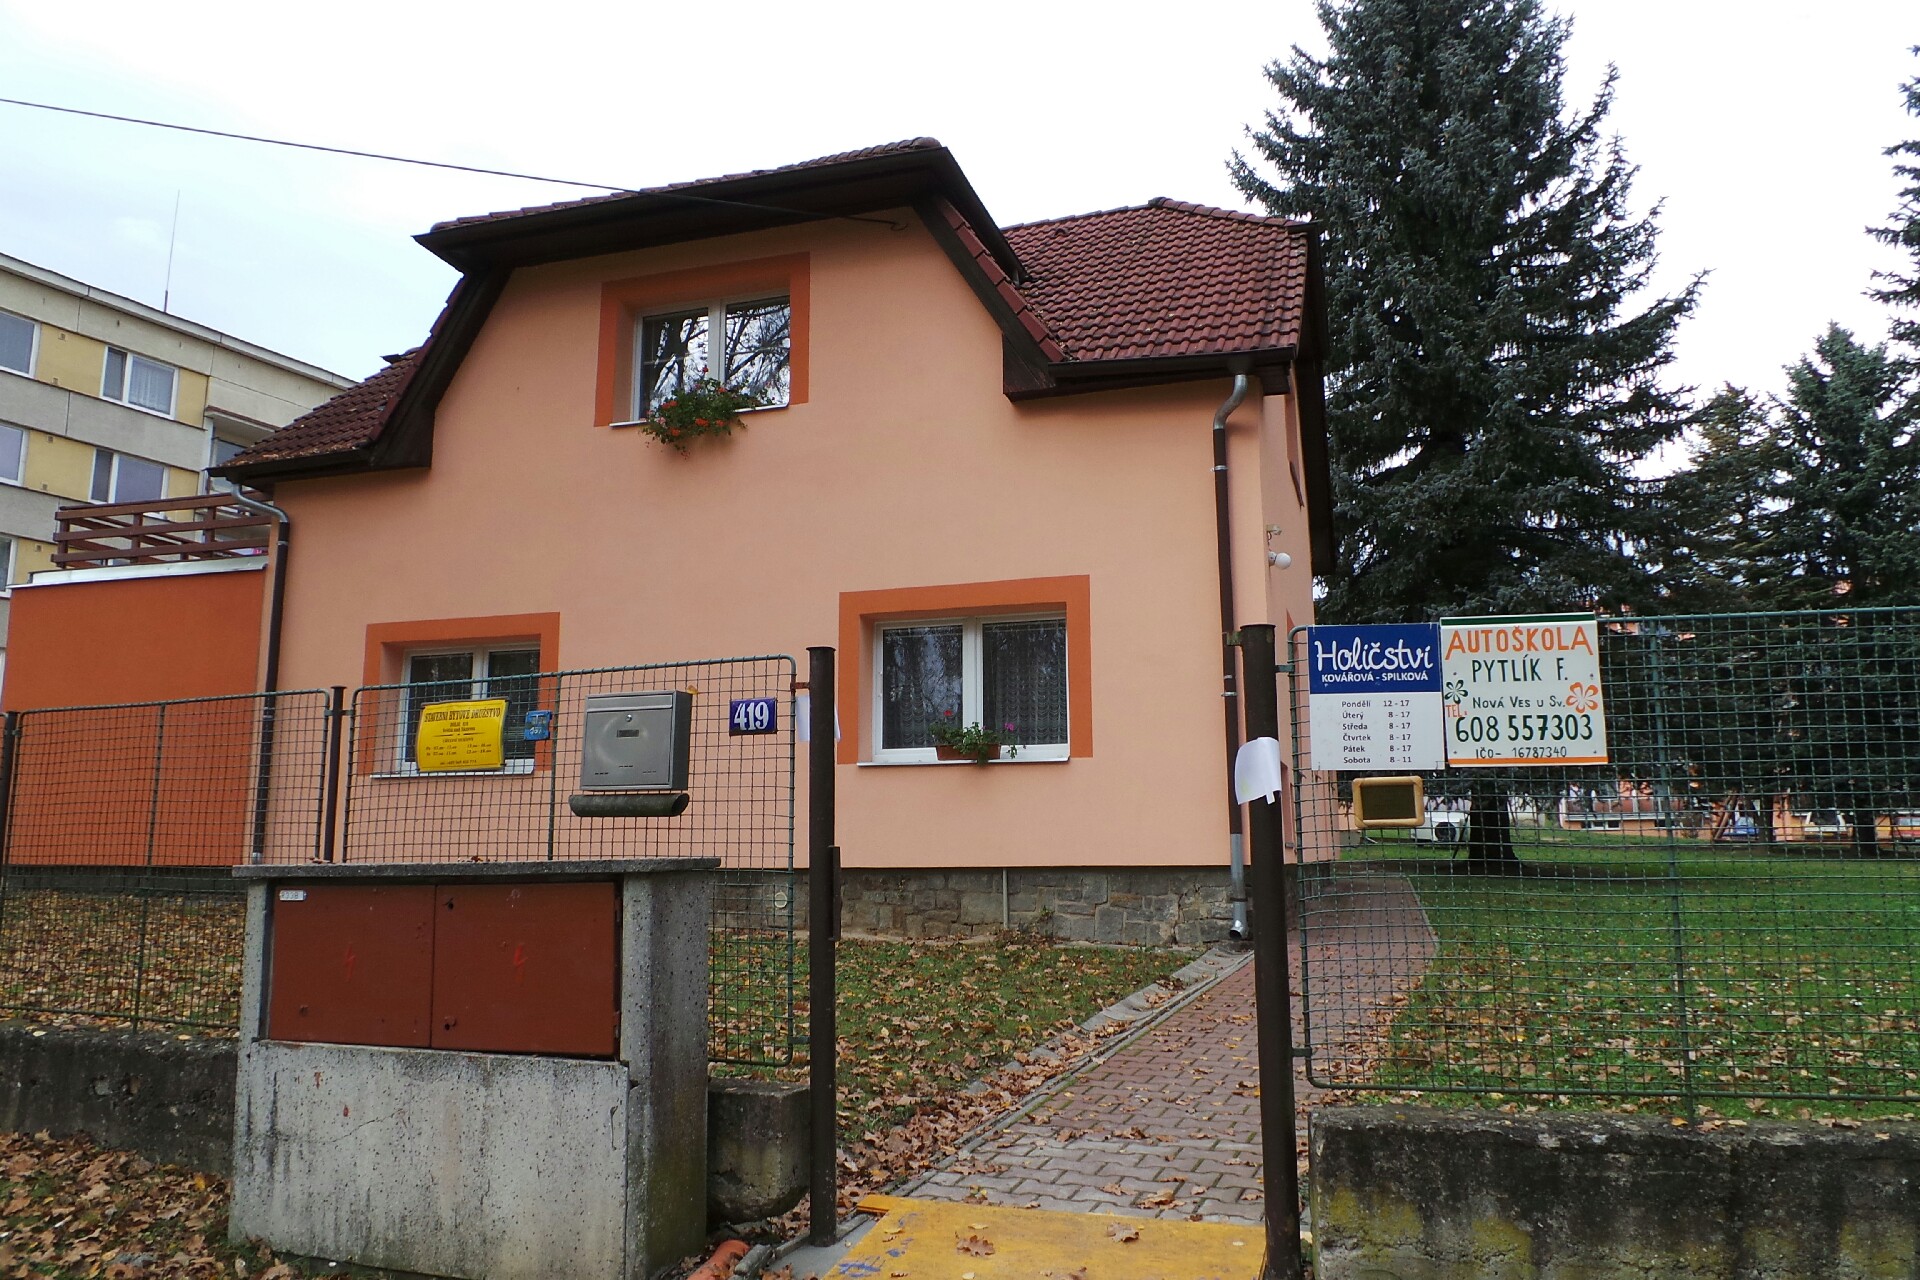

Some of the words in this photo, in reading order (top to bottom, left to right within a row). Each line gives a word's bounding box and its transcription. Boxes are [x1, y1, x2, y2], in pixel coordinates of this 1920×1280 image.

[1445, 625, 1594, 660] AUTOŠKOLA
[1314, 637, 1433, 671] Holičství
[1472, 654, 1542, 682] PYTLÍK
[1556, 657, 1568, 681] F.
[1322, 670, 1374, 683] KOVÁŘOVÁ
[1382, 670, 1428, 682] SPILKOVÁ
[1341, 700, 1371, 708] Pondělí
[1383, 700, 1393, 708] 12
[734, 701, 769, 730] 419
[1342, 710, 1364, 720] Úterý
[1342, 722, 1368, 730] Středa
[1456, 715, 1500, 742] 608
[1508, 714, 1593, 741] 557303
[1342, 732, 1372, 742] Čtvrtek
[1512, 746, 1567, 758] 16787340
